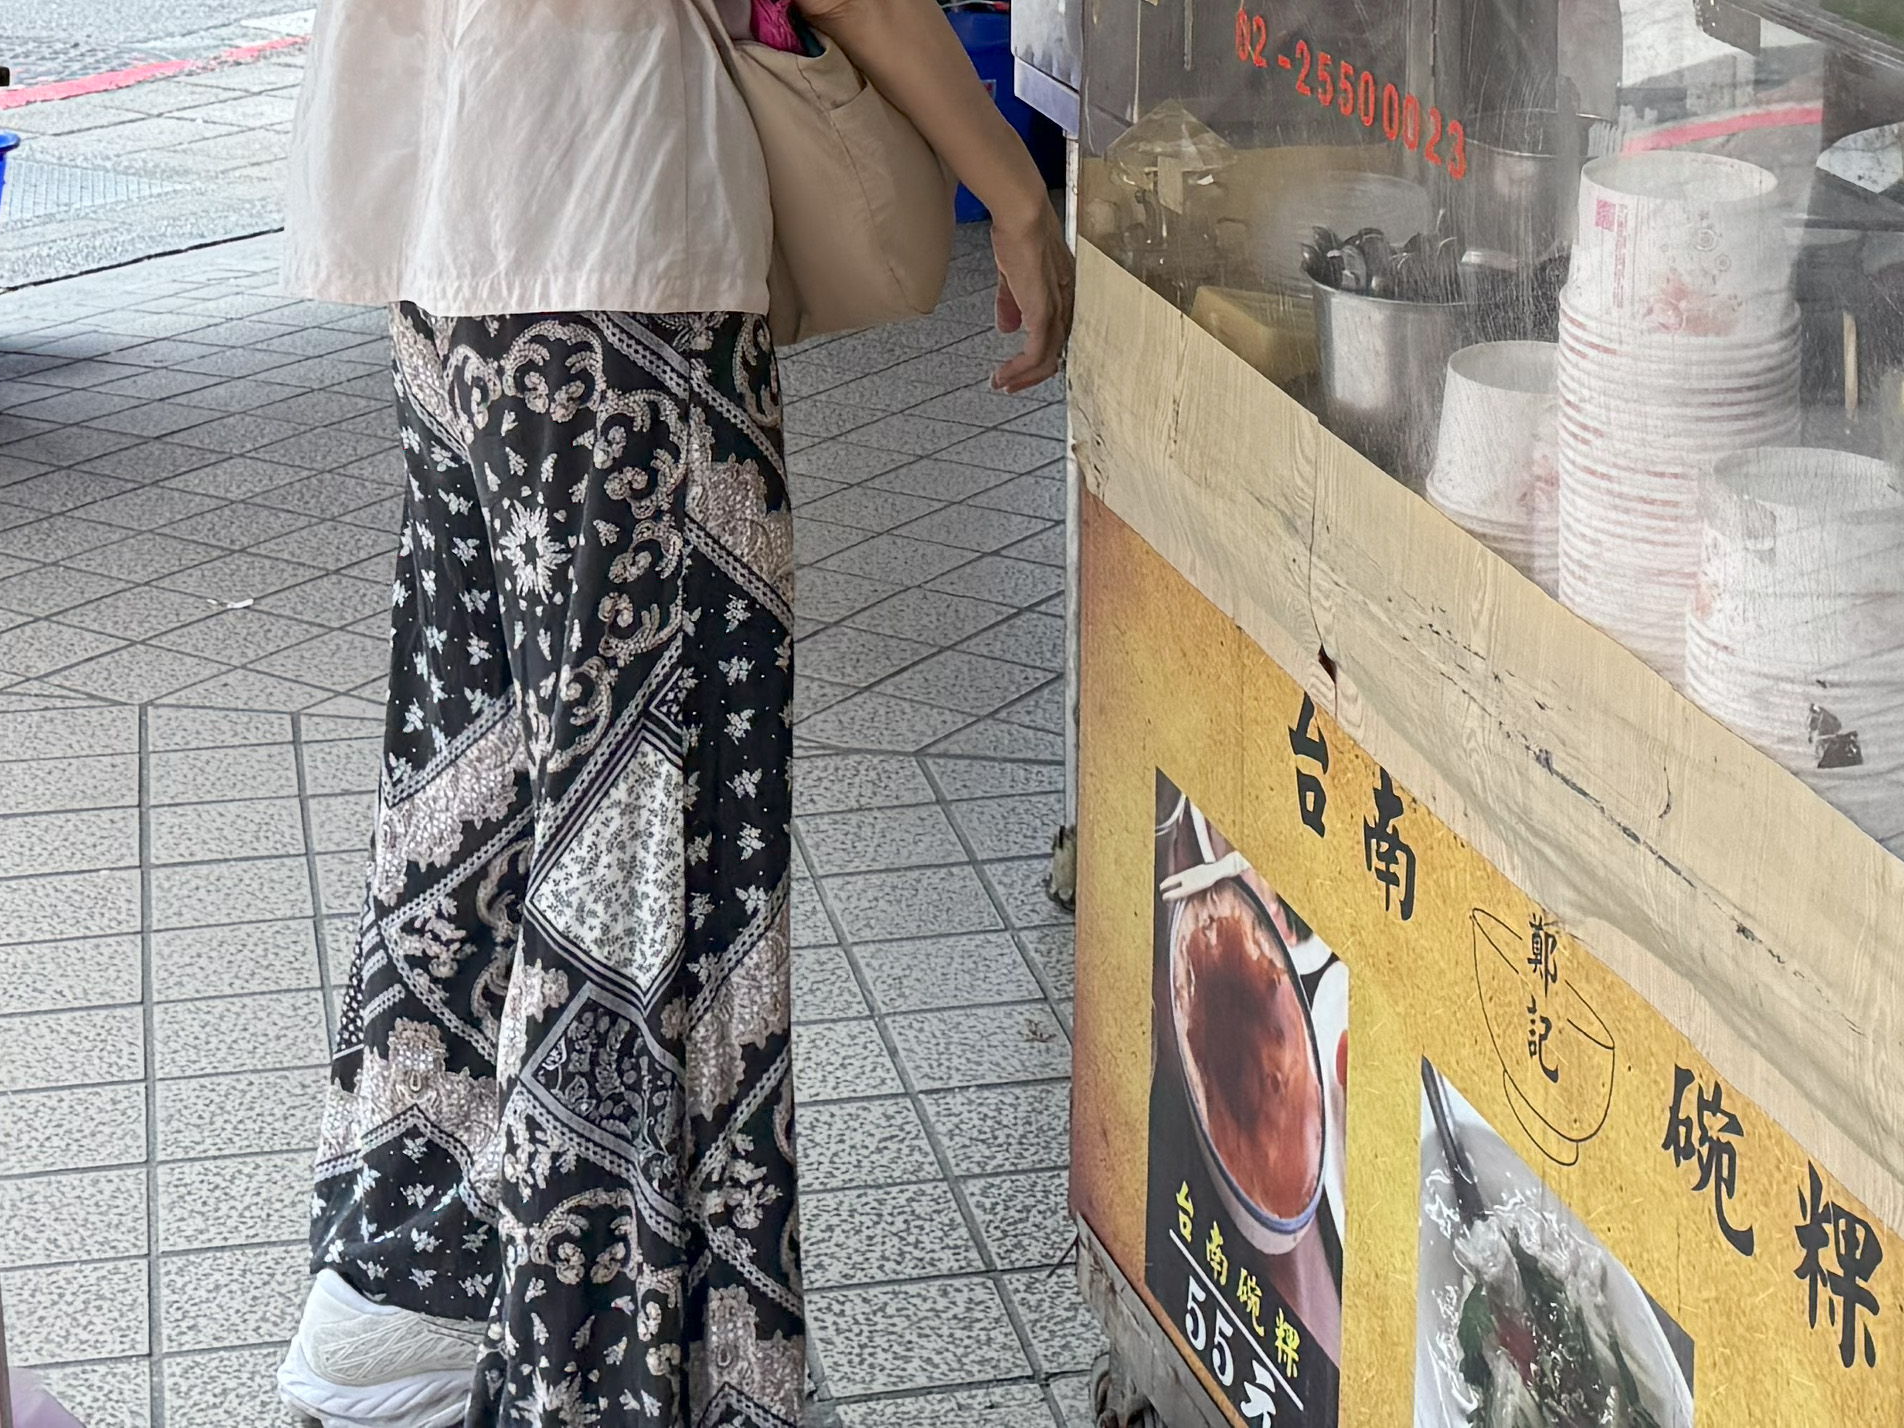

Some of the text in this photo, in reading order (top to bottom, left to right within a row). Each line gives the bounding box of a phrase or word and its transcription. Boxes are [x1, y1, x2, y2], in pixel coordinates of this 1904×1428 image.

[1234, 7, 1467, 180] 02-25500023
[1286, 692, 1884, 1370] 台南 碗粿
[1525, 912, 1560, 1087] 鄭記
[1175, 1180, 1301, 1378] 台南碗粿
